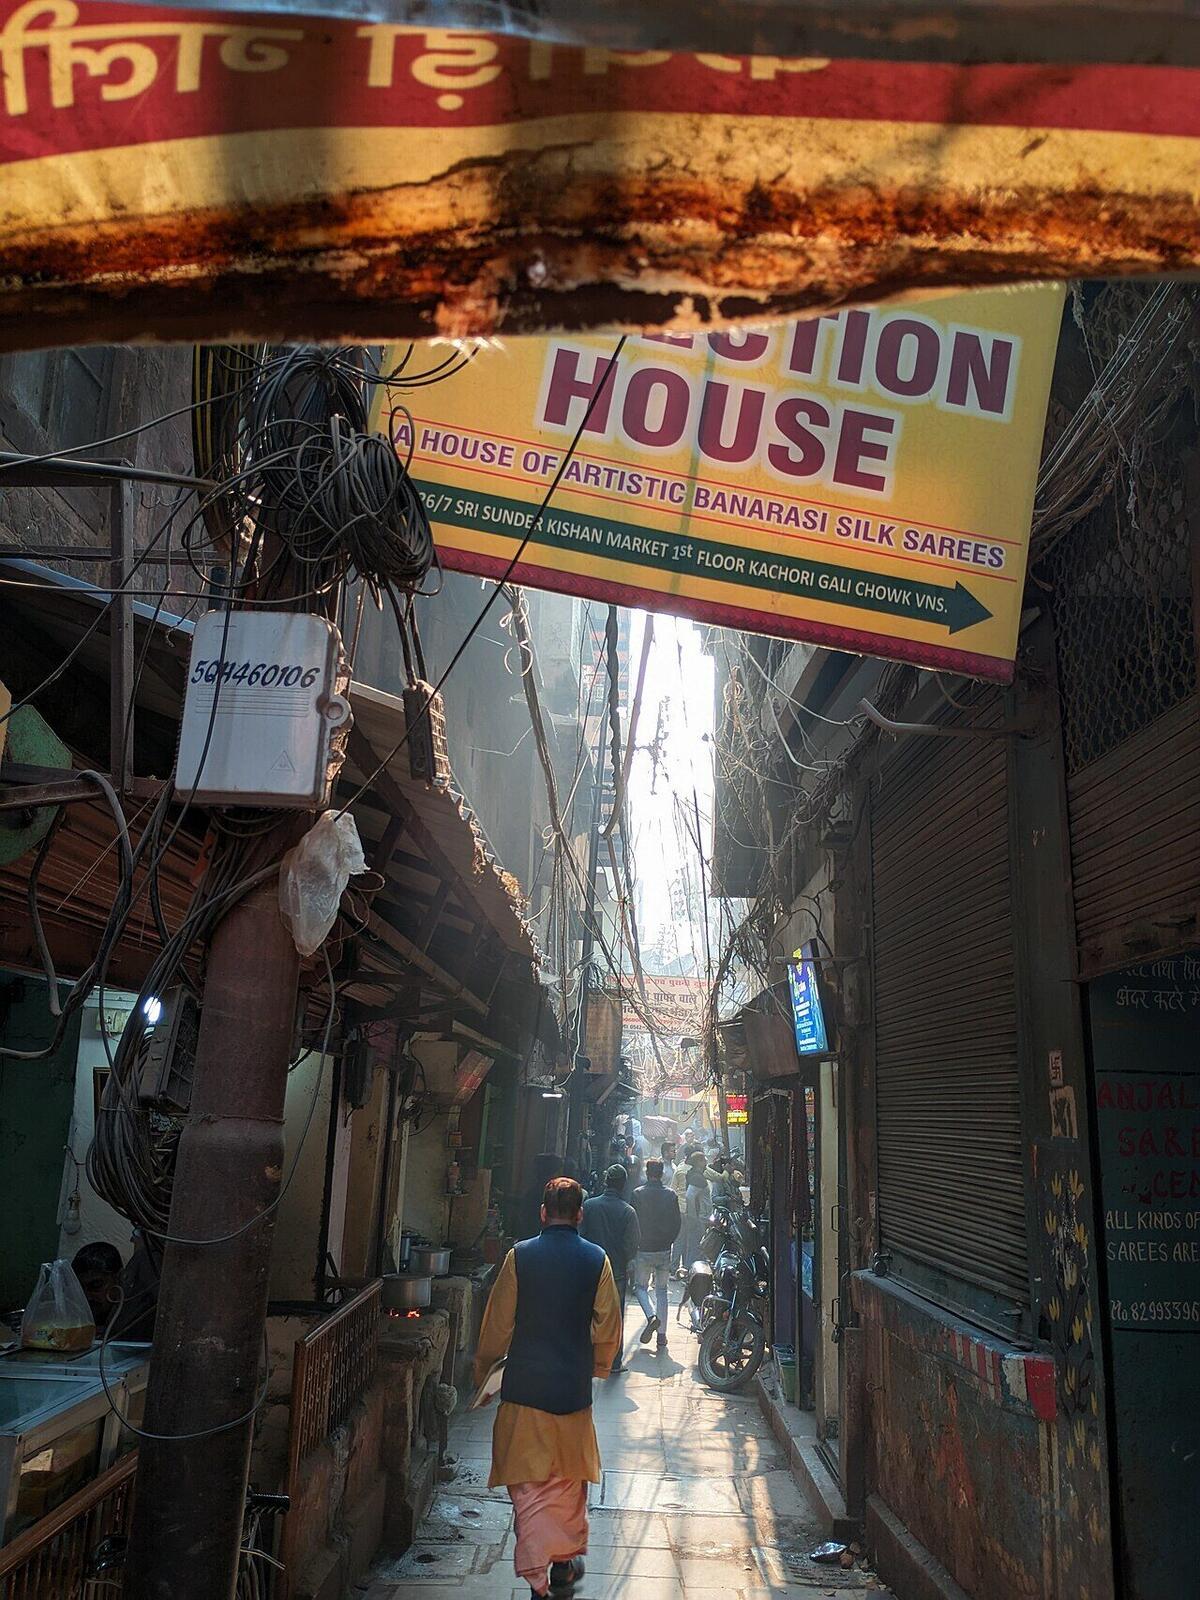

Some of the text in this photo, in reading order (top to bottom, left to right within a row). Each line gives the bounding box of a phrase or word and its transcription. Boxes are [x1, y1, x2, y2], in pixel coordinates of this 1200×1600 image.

[640, 309, 1013, 414] TION
[543, 347, 895, 492] HOUSE
[394, 424, 1004, 569] A HOUSE OF ARTISTIC BANARASI SILK SAREES
[454, 500, 479, 518] SRI
[482, 505, 542, 531] SUNDER
[546, 518, 603, 543] KISHAN
[606, 530, 669, 560] MARKET
[672, 543, 693, 561] 1st
[697, 550, 744, 574] FLOOR
[749, 560, 815, 586] KACHORI
[818, 573, 851, 594] GALI
[855, 581, 911, 606] CHOWK
[915, 592, 948, 613] VNS.
[1105, 1210, 1200, 1230] ALL KINDS OF
[1106, 1240, 1200, 1263] SAREES ARE
